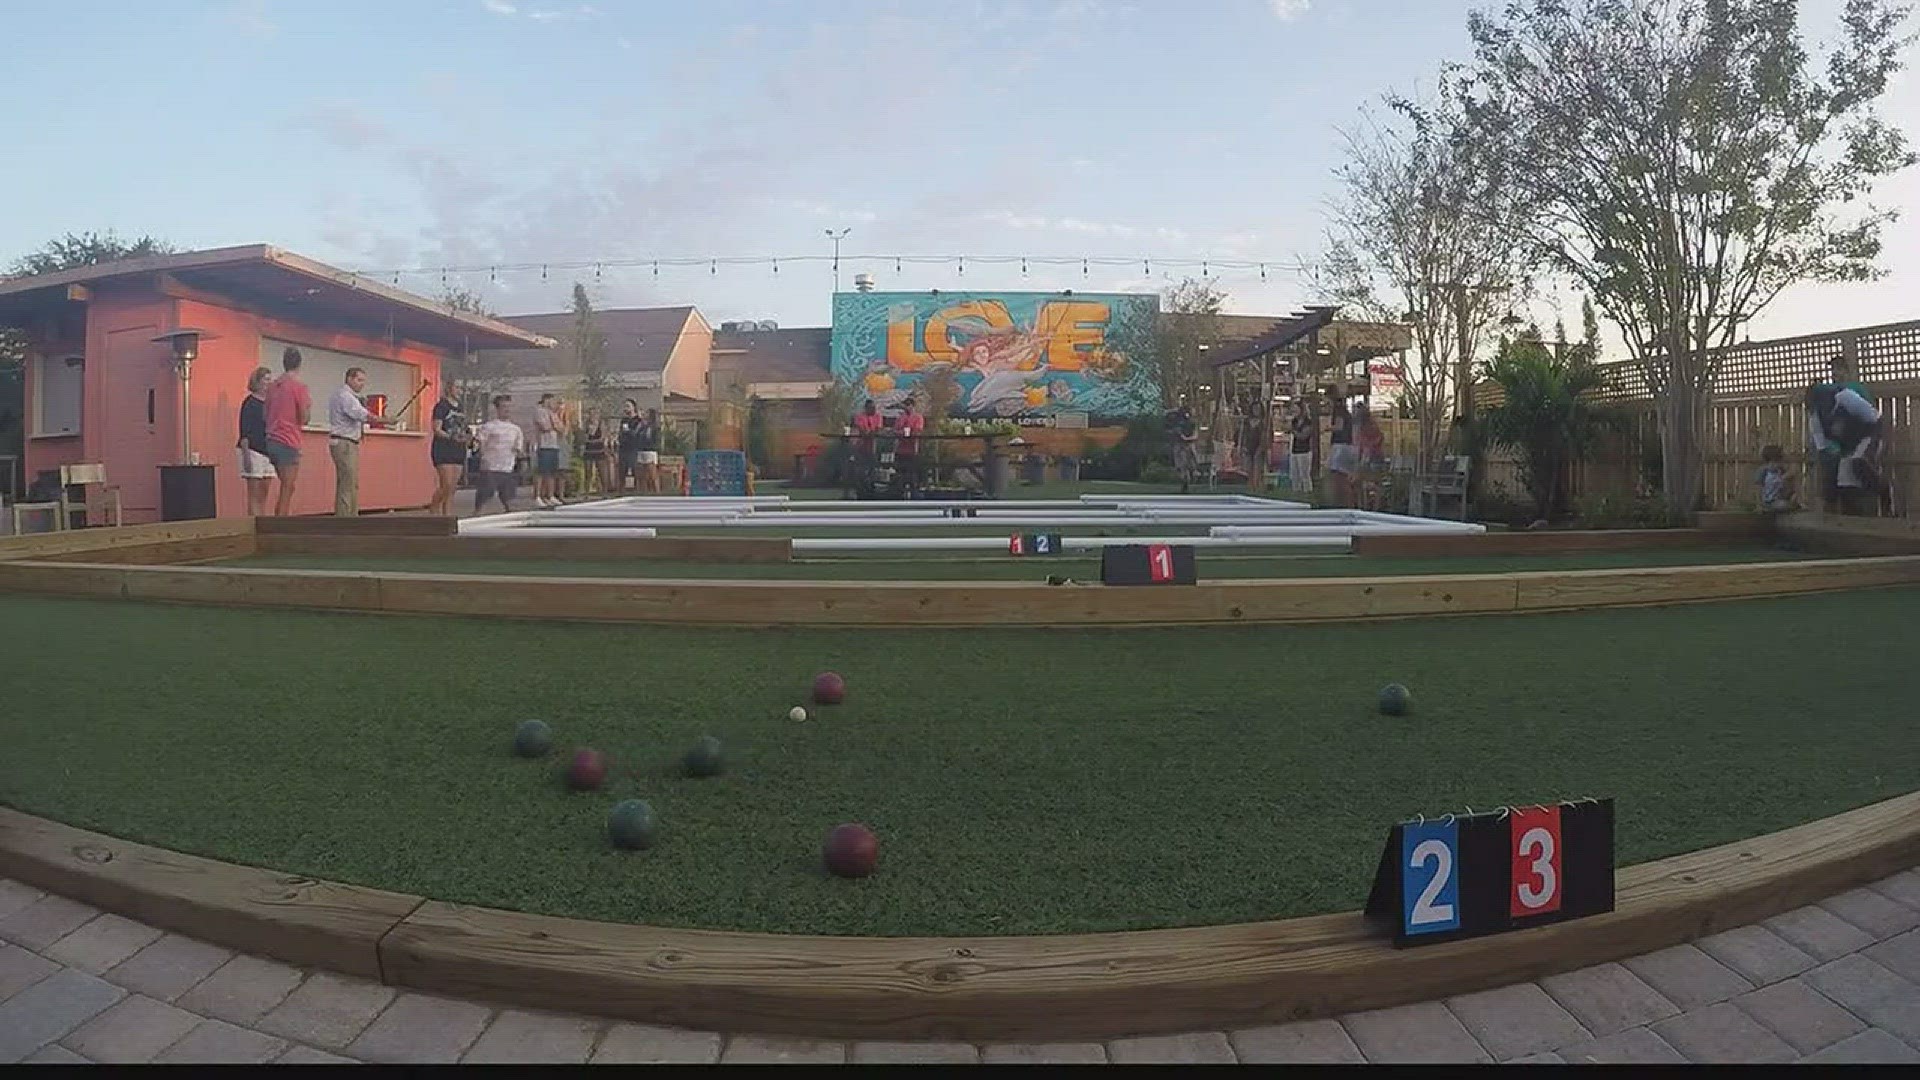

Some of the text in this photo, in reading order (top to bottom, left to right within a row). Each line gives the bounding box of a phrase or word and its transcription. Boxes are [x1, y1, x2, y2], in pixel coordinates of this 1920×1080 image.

[887, 299, 1111, 372] LOVE
[1037, 536, 1049, 552] 2
[1156, 550, 1169, 578] 1
[1410, 827, 1556, 925] 2 3
